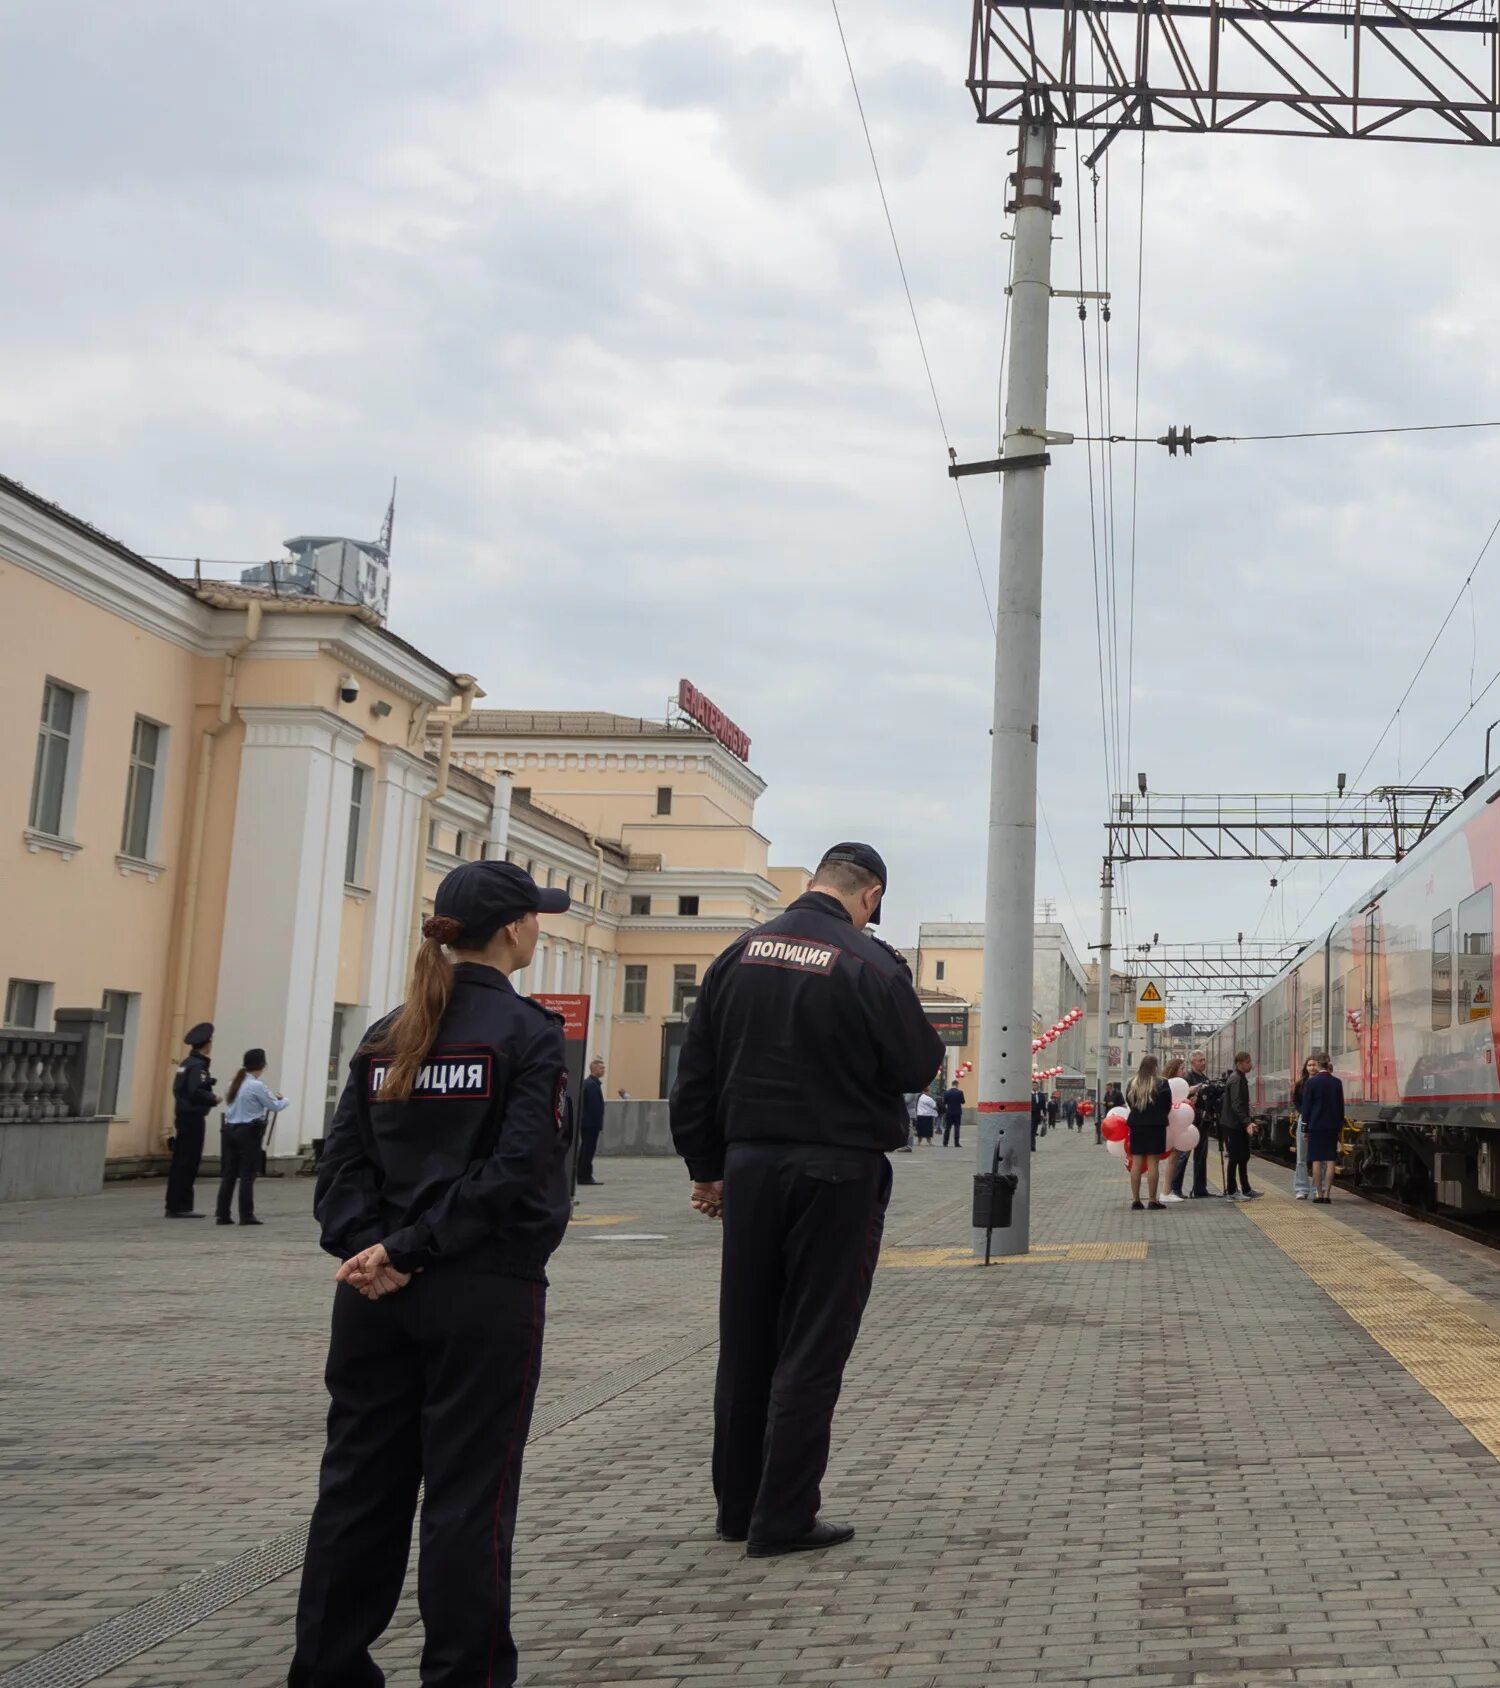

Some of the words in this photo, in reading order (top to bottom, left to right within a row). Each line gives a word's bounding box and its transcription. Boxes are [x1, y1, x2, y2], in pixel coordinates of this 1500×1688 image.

[679, 679, 752, 762] ЕКАТЕРИНБУРГ
[748, 941, 832, 967] ПОЛИЦИЯ
[372, 1064, 483, 1094] ПИЦИЯ
